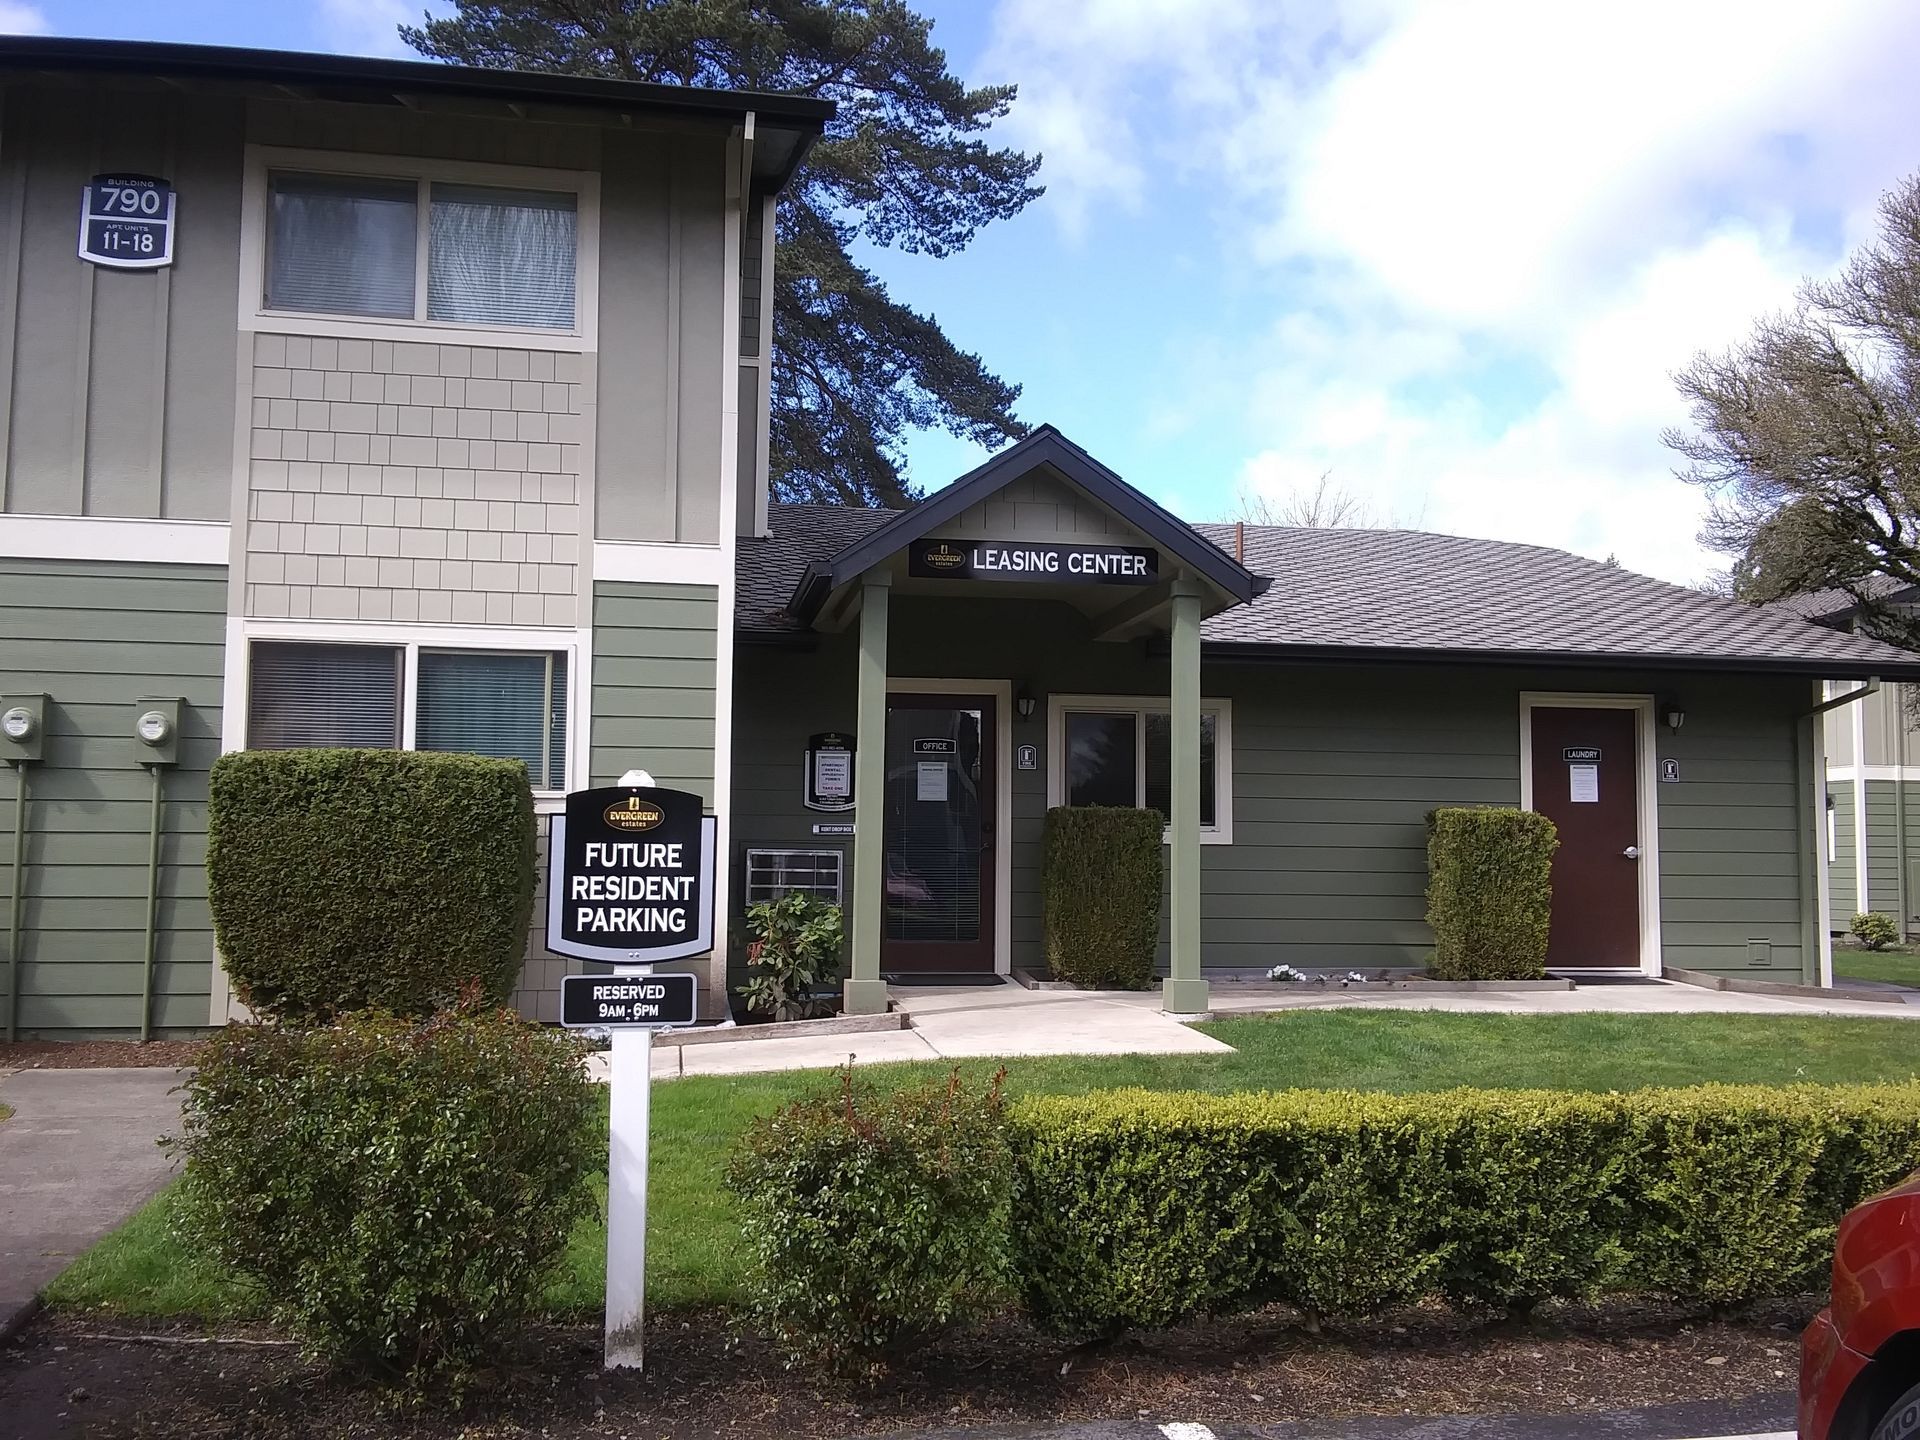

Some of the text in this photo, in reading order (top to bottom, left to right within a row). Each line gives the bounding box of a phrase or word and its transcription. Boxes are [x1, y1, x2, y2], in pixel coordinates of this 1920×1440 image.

[107, 178, 154, 188] BUILDING
[101, 187, 160, 214] 790
[124, 224, 149, 232] UNITS
[103, 231, 153, 253] 11-18
[972, 549, 1147, 576] LEASING CENTER
[922, 742, 948, 750] OFFICE
[1567, 750, 1598, 759] LAUNDRY
[609, 811, 659, 821] EVERGREEN
[584, 842, 683, 868] FUTURE
[571, 875, 695, 901] RESIDENT
[576, 907, 687, 933] PARKING
[592, 985, 666, 1000] RESERVED
